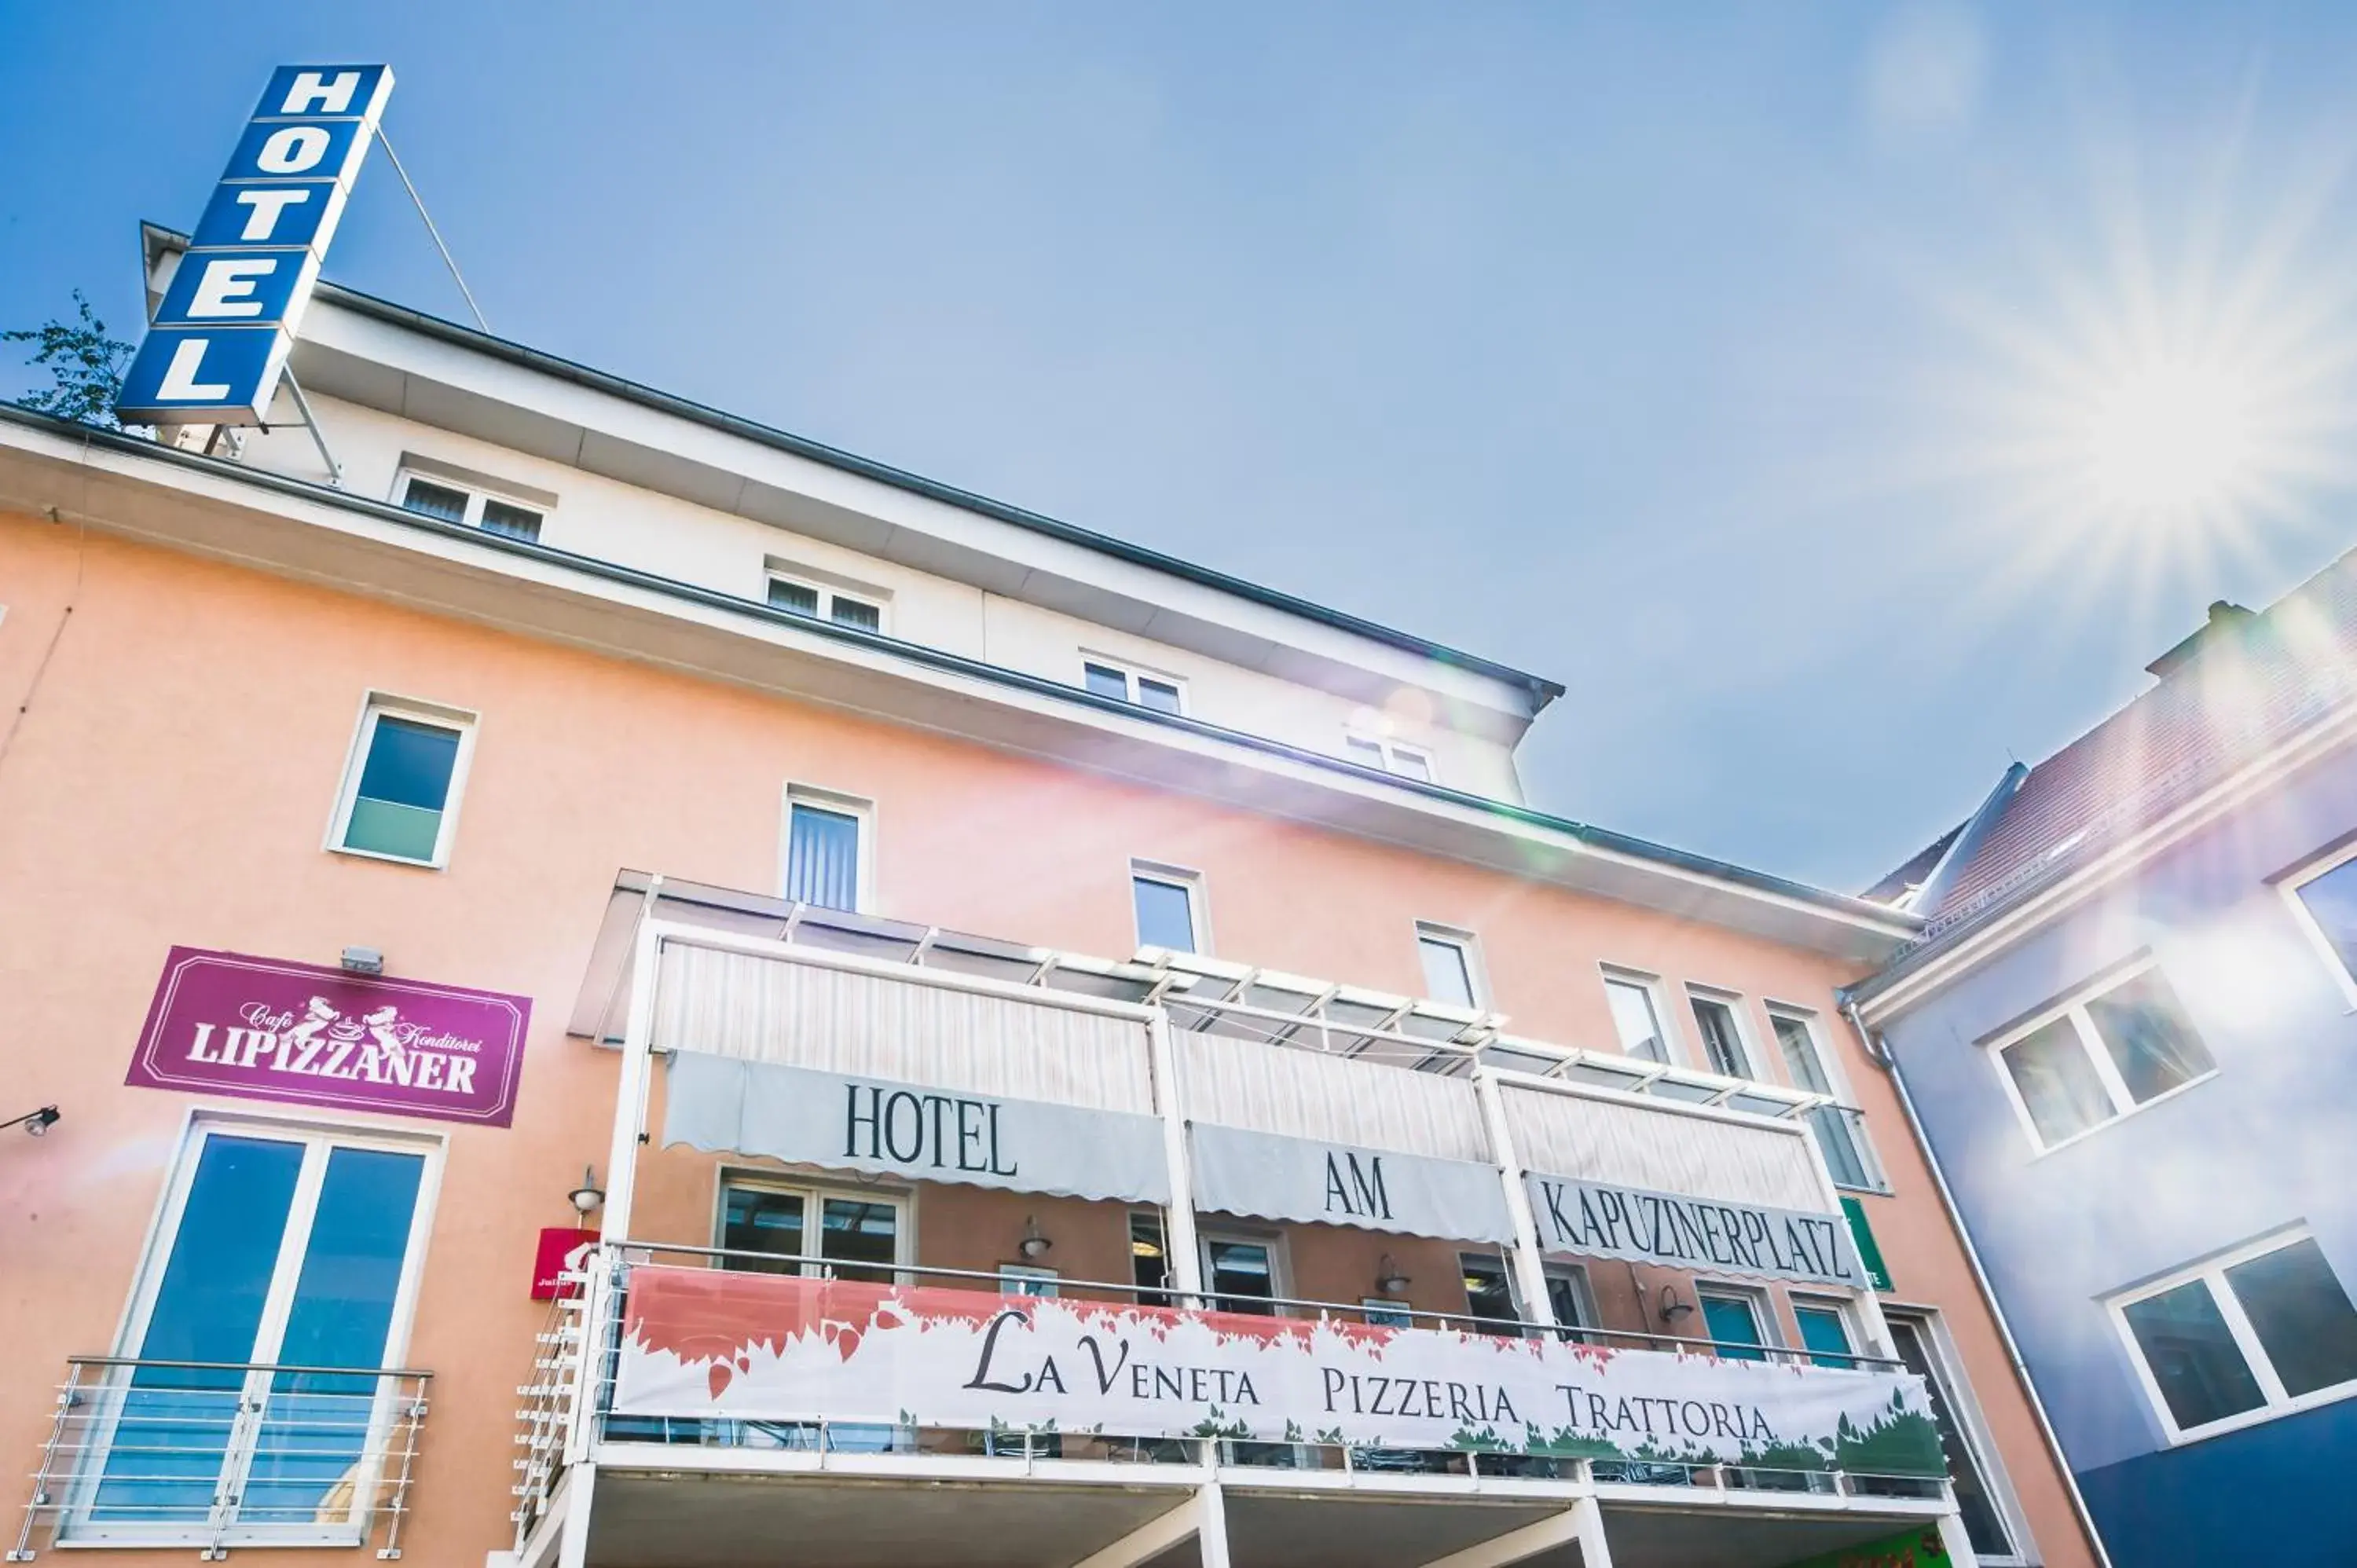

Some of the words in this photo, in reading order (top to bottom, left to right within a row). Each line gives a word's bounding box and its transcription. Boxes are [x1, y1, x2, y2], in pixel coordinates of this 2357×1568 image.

[156, 71, 361, 400] HOTEL
[185, 1022, 477, 1094] LIPIZZANER
[843, 1083, 1017, 1176] HOTEL
[1325, 1151, 1394, 1219] AM
[1541, 1181, 1851, 1278] KAPUZINERPLATZ
[963, 1311, 1069, 1394] LA
[1077, 1335, 1261, 1405] VENETA
[1321, 1368, 1520, 1423] PIZZERIA
[1555, 1384, 1774, 1439] TRATTORIA
